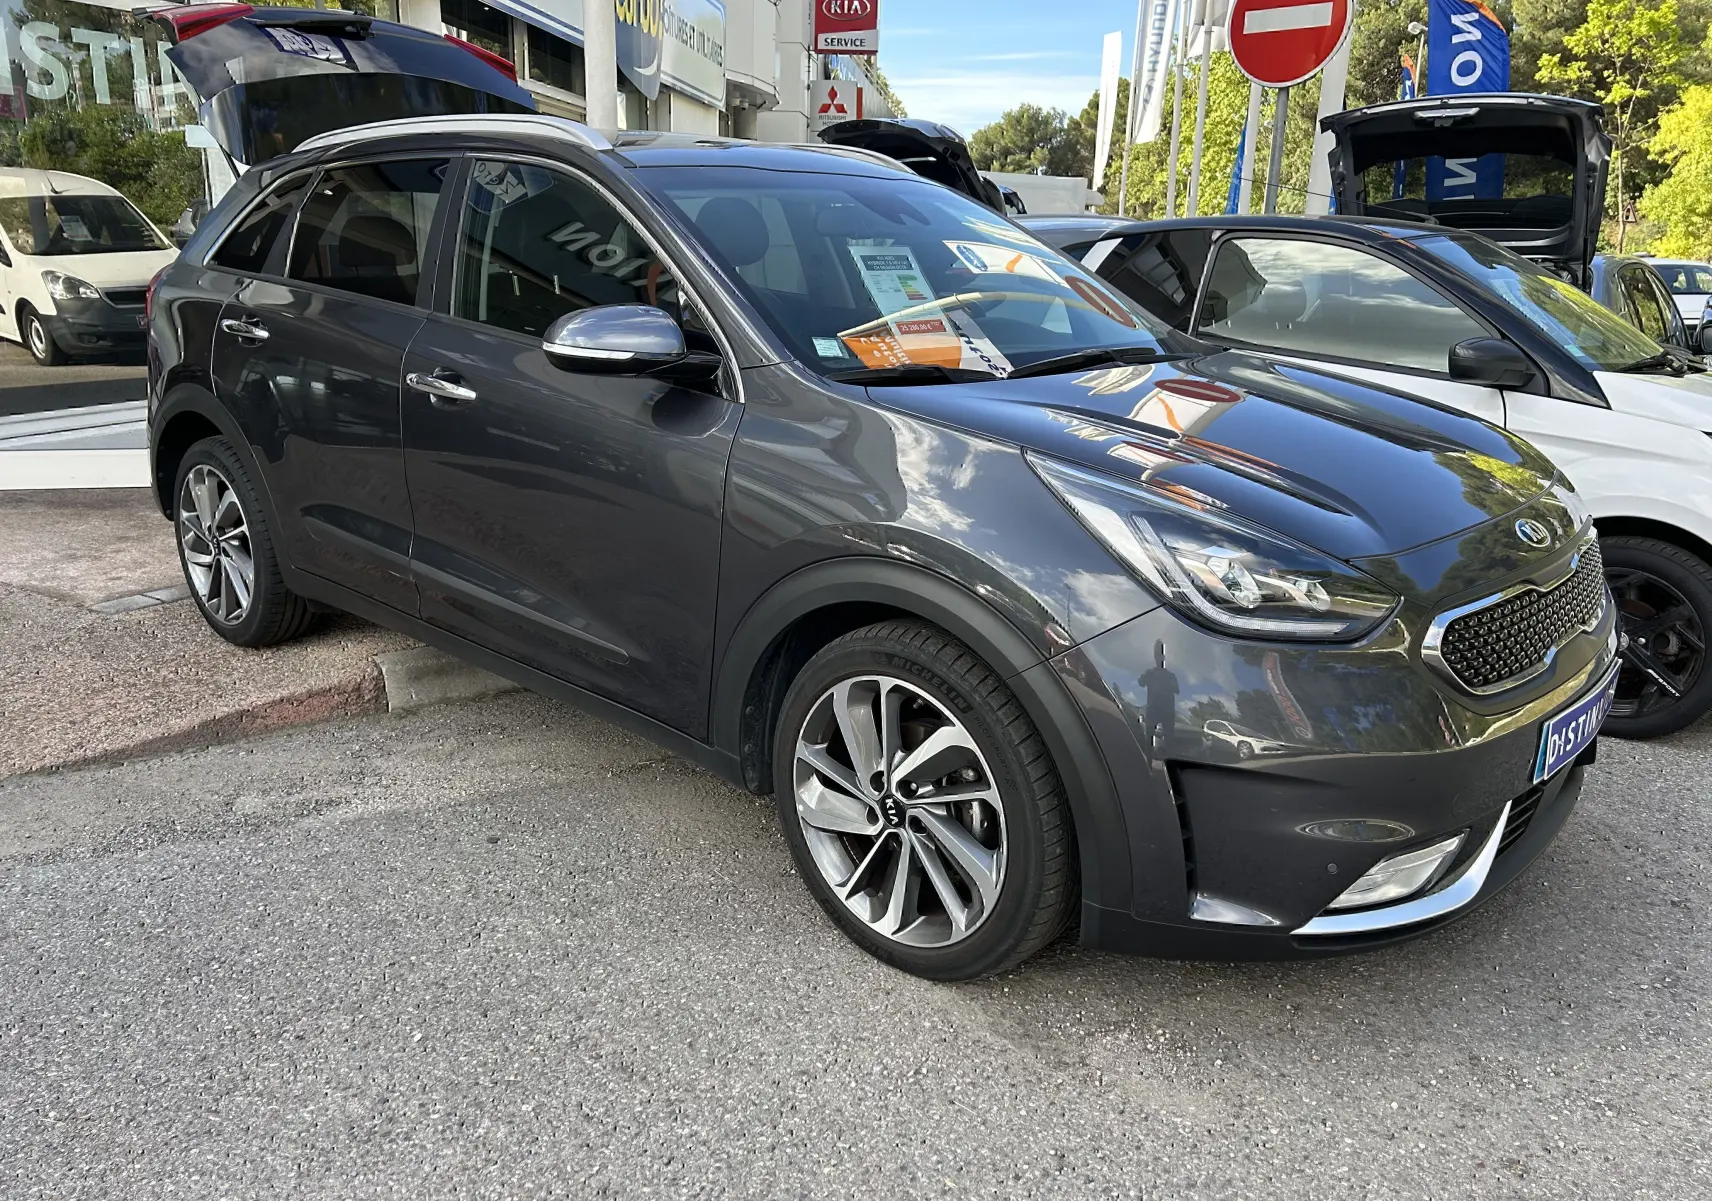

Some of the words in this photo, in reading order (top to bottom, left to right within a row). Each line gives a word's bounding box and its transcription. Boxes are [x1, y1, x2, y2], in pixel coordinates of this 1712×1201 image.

[831, 0, 862, 15] KIA
[824, 37, 866, 47] SERVICE
[1147, 0, 1168, 73] HYUND
[891, 656, 969, 710] MICHELIN
[974, 716, 992, 739] PILOT
[885, 798, 897, 825] KIA
